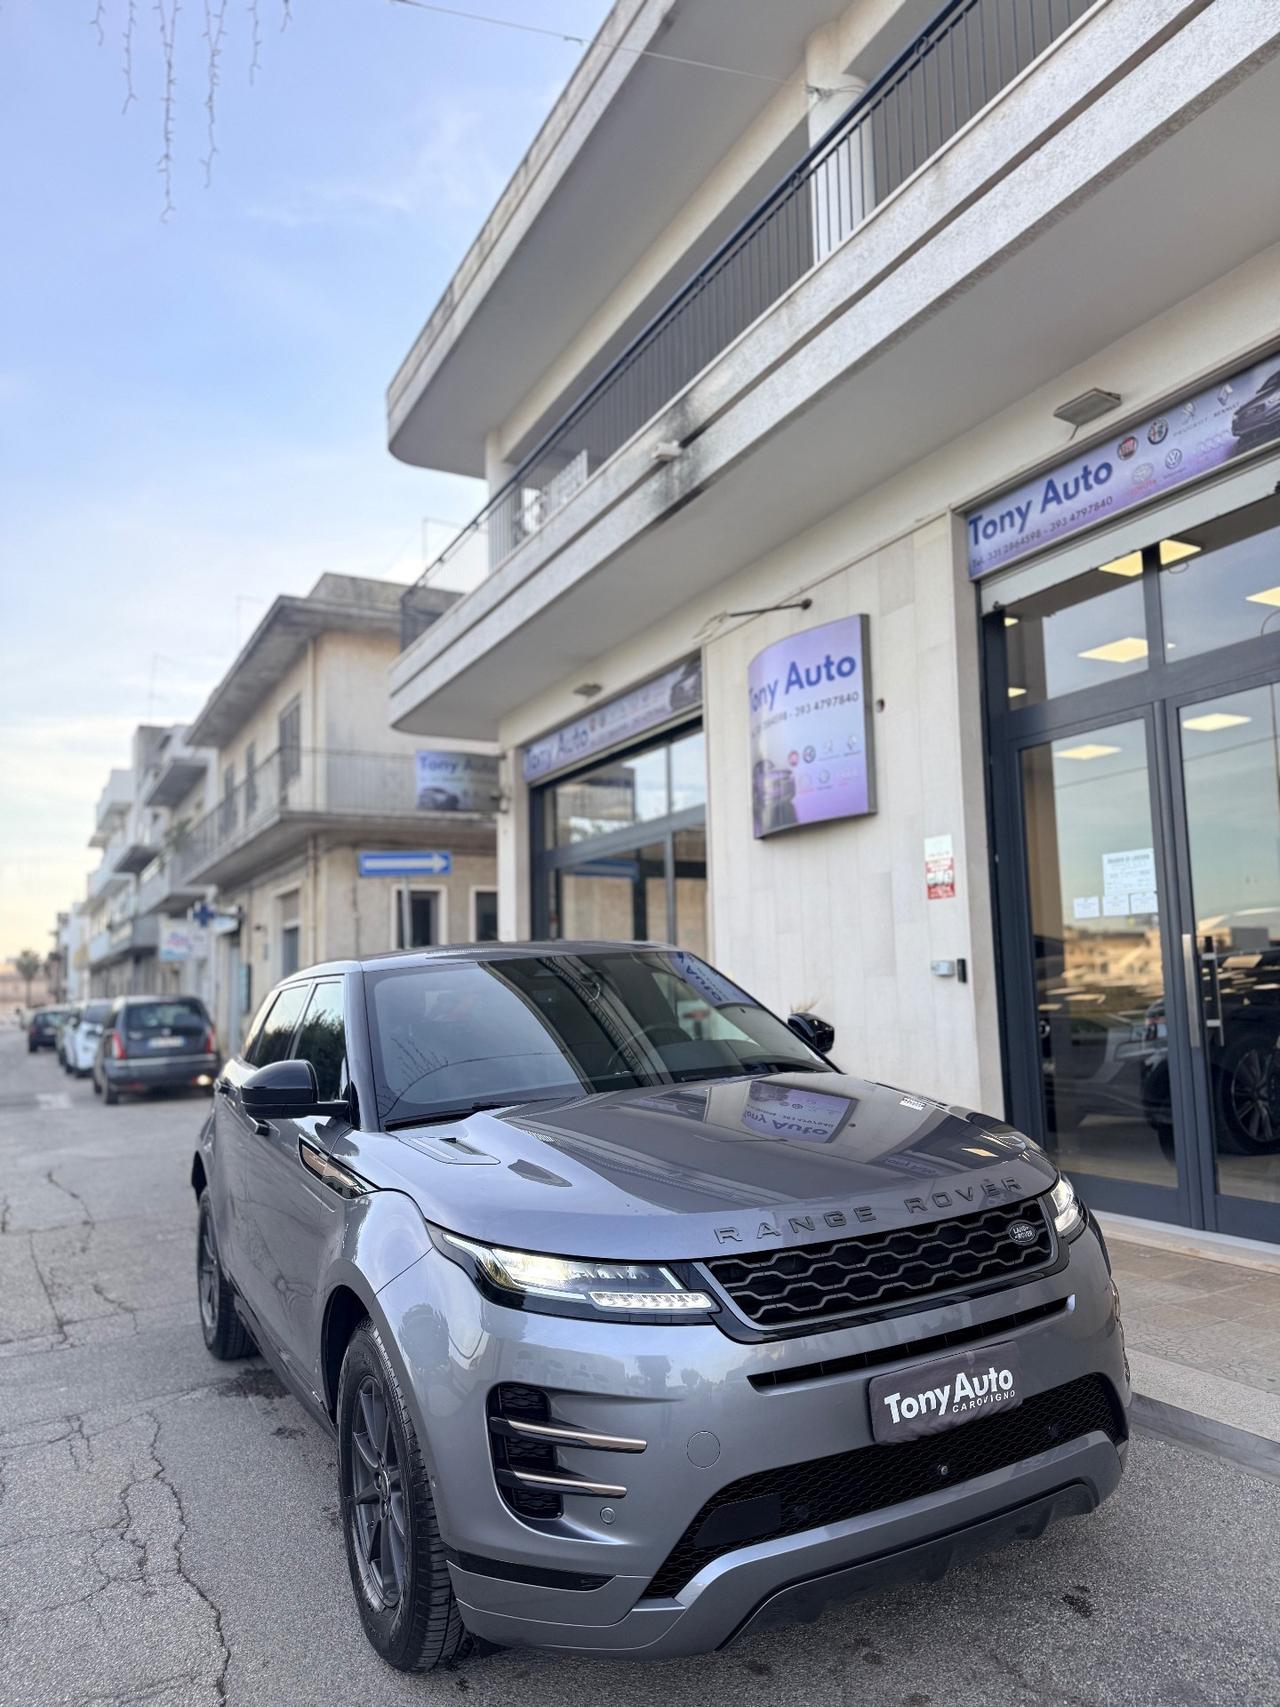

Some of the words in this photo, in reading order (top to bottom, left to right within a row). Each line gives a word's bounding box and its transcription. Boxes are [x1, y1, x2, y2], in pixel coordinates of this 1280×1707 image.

[969, 499, 1033, 546] Tony
[1040, 462, 1113, 514] Auto
[1050, 517, 1068, 532] 393
[1069, 496, 1113, 521] 4797840
[785, 654, 856, 695] Auto
[713, 1205, 877, 1244] RANGE
[903, 1176, 1023, 1214] ROVER
[952, 1390, 1016, 1413] CAROVIGNO
